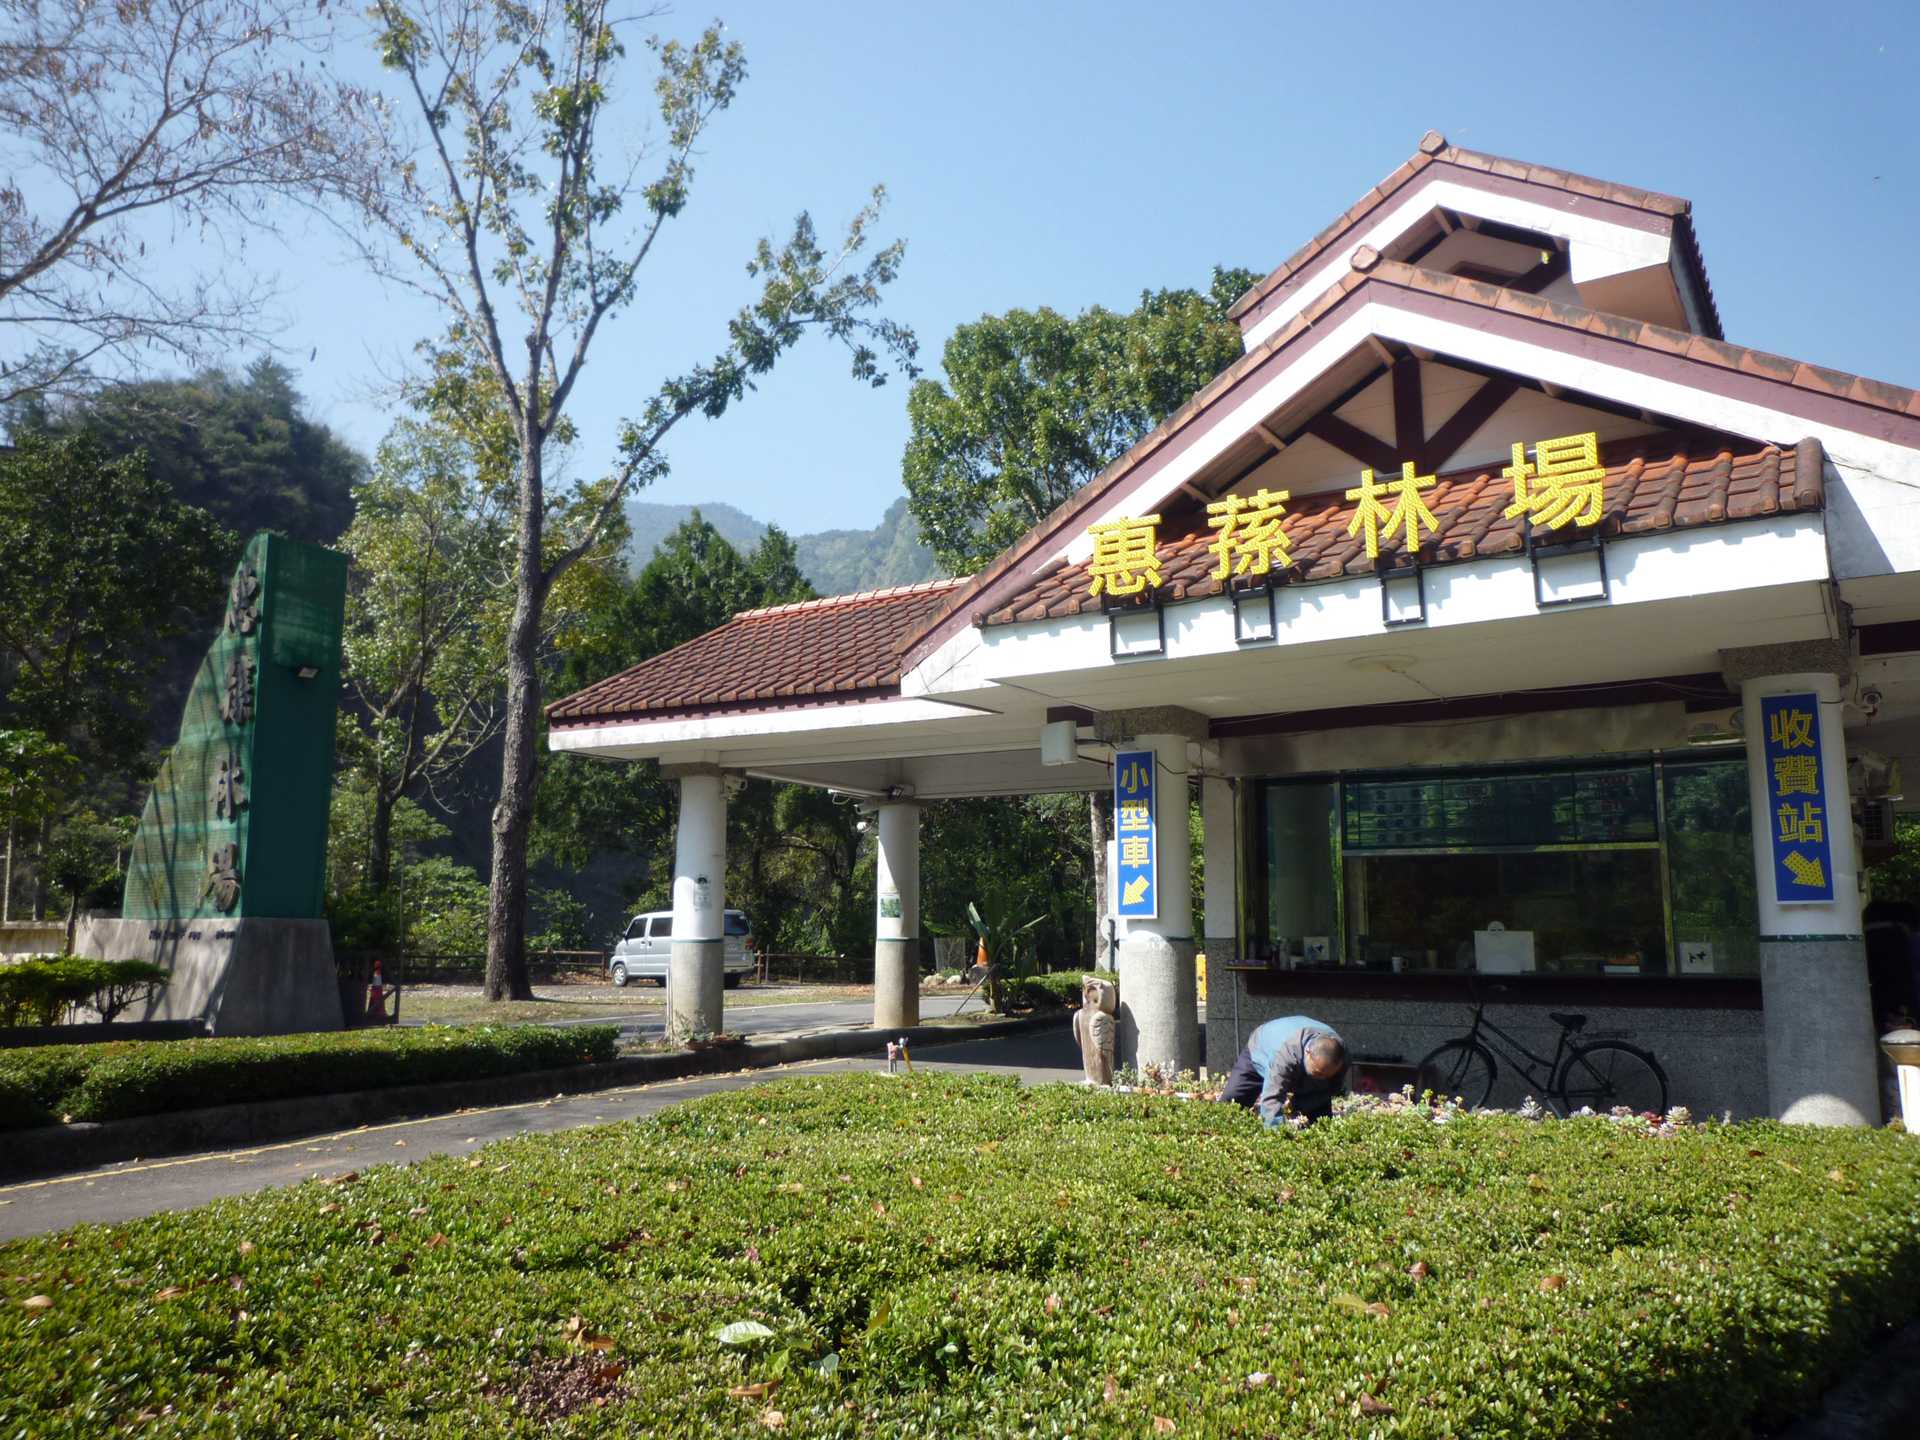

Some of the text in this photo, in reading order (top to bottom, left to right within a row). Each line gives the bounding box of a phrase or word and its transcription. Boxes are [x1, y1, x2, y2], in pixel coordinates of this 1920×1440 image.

[1087, 432, 1606, 597] 惠蓀林場
[1120, 761, 1150, 868] 小型車
[1770, 709, 1824, 843] 收費站
